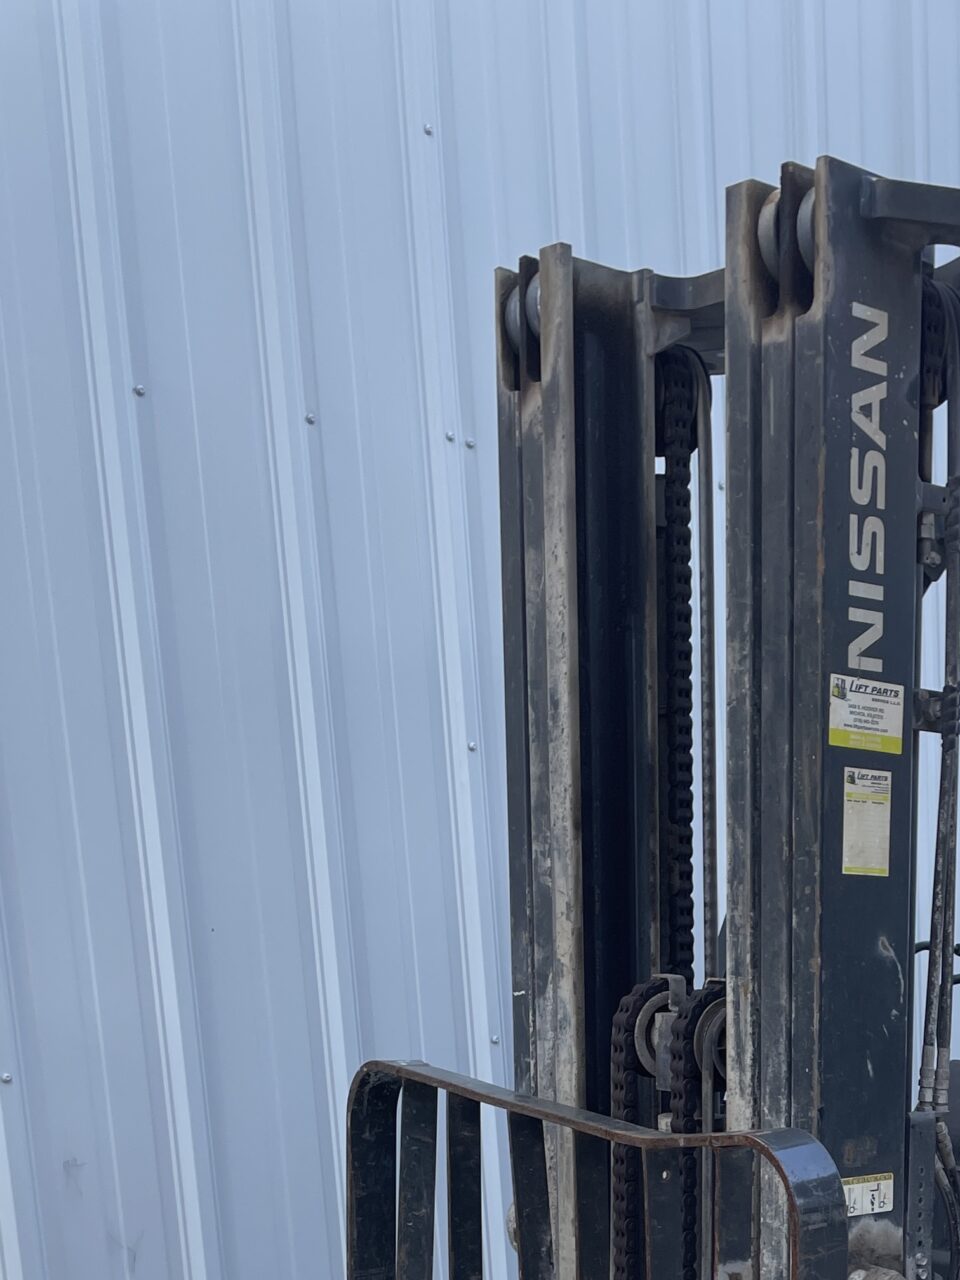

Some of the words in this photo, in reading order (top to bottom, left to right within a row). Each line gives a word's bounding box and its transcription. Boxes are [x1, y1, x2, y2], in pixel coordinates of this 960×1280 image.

[848, 302, 889, 672] NISSAN
[849, 680, 870, 693] LIFT
[871, 686, 900, 698] PARTS
